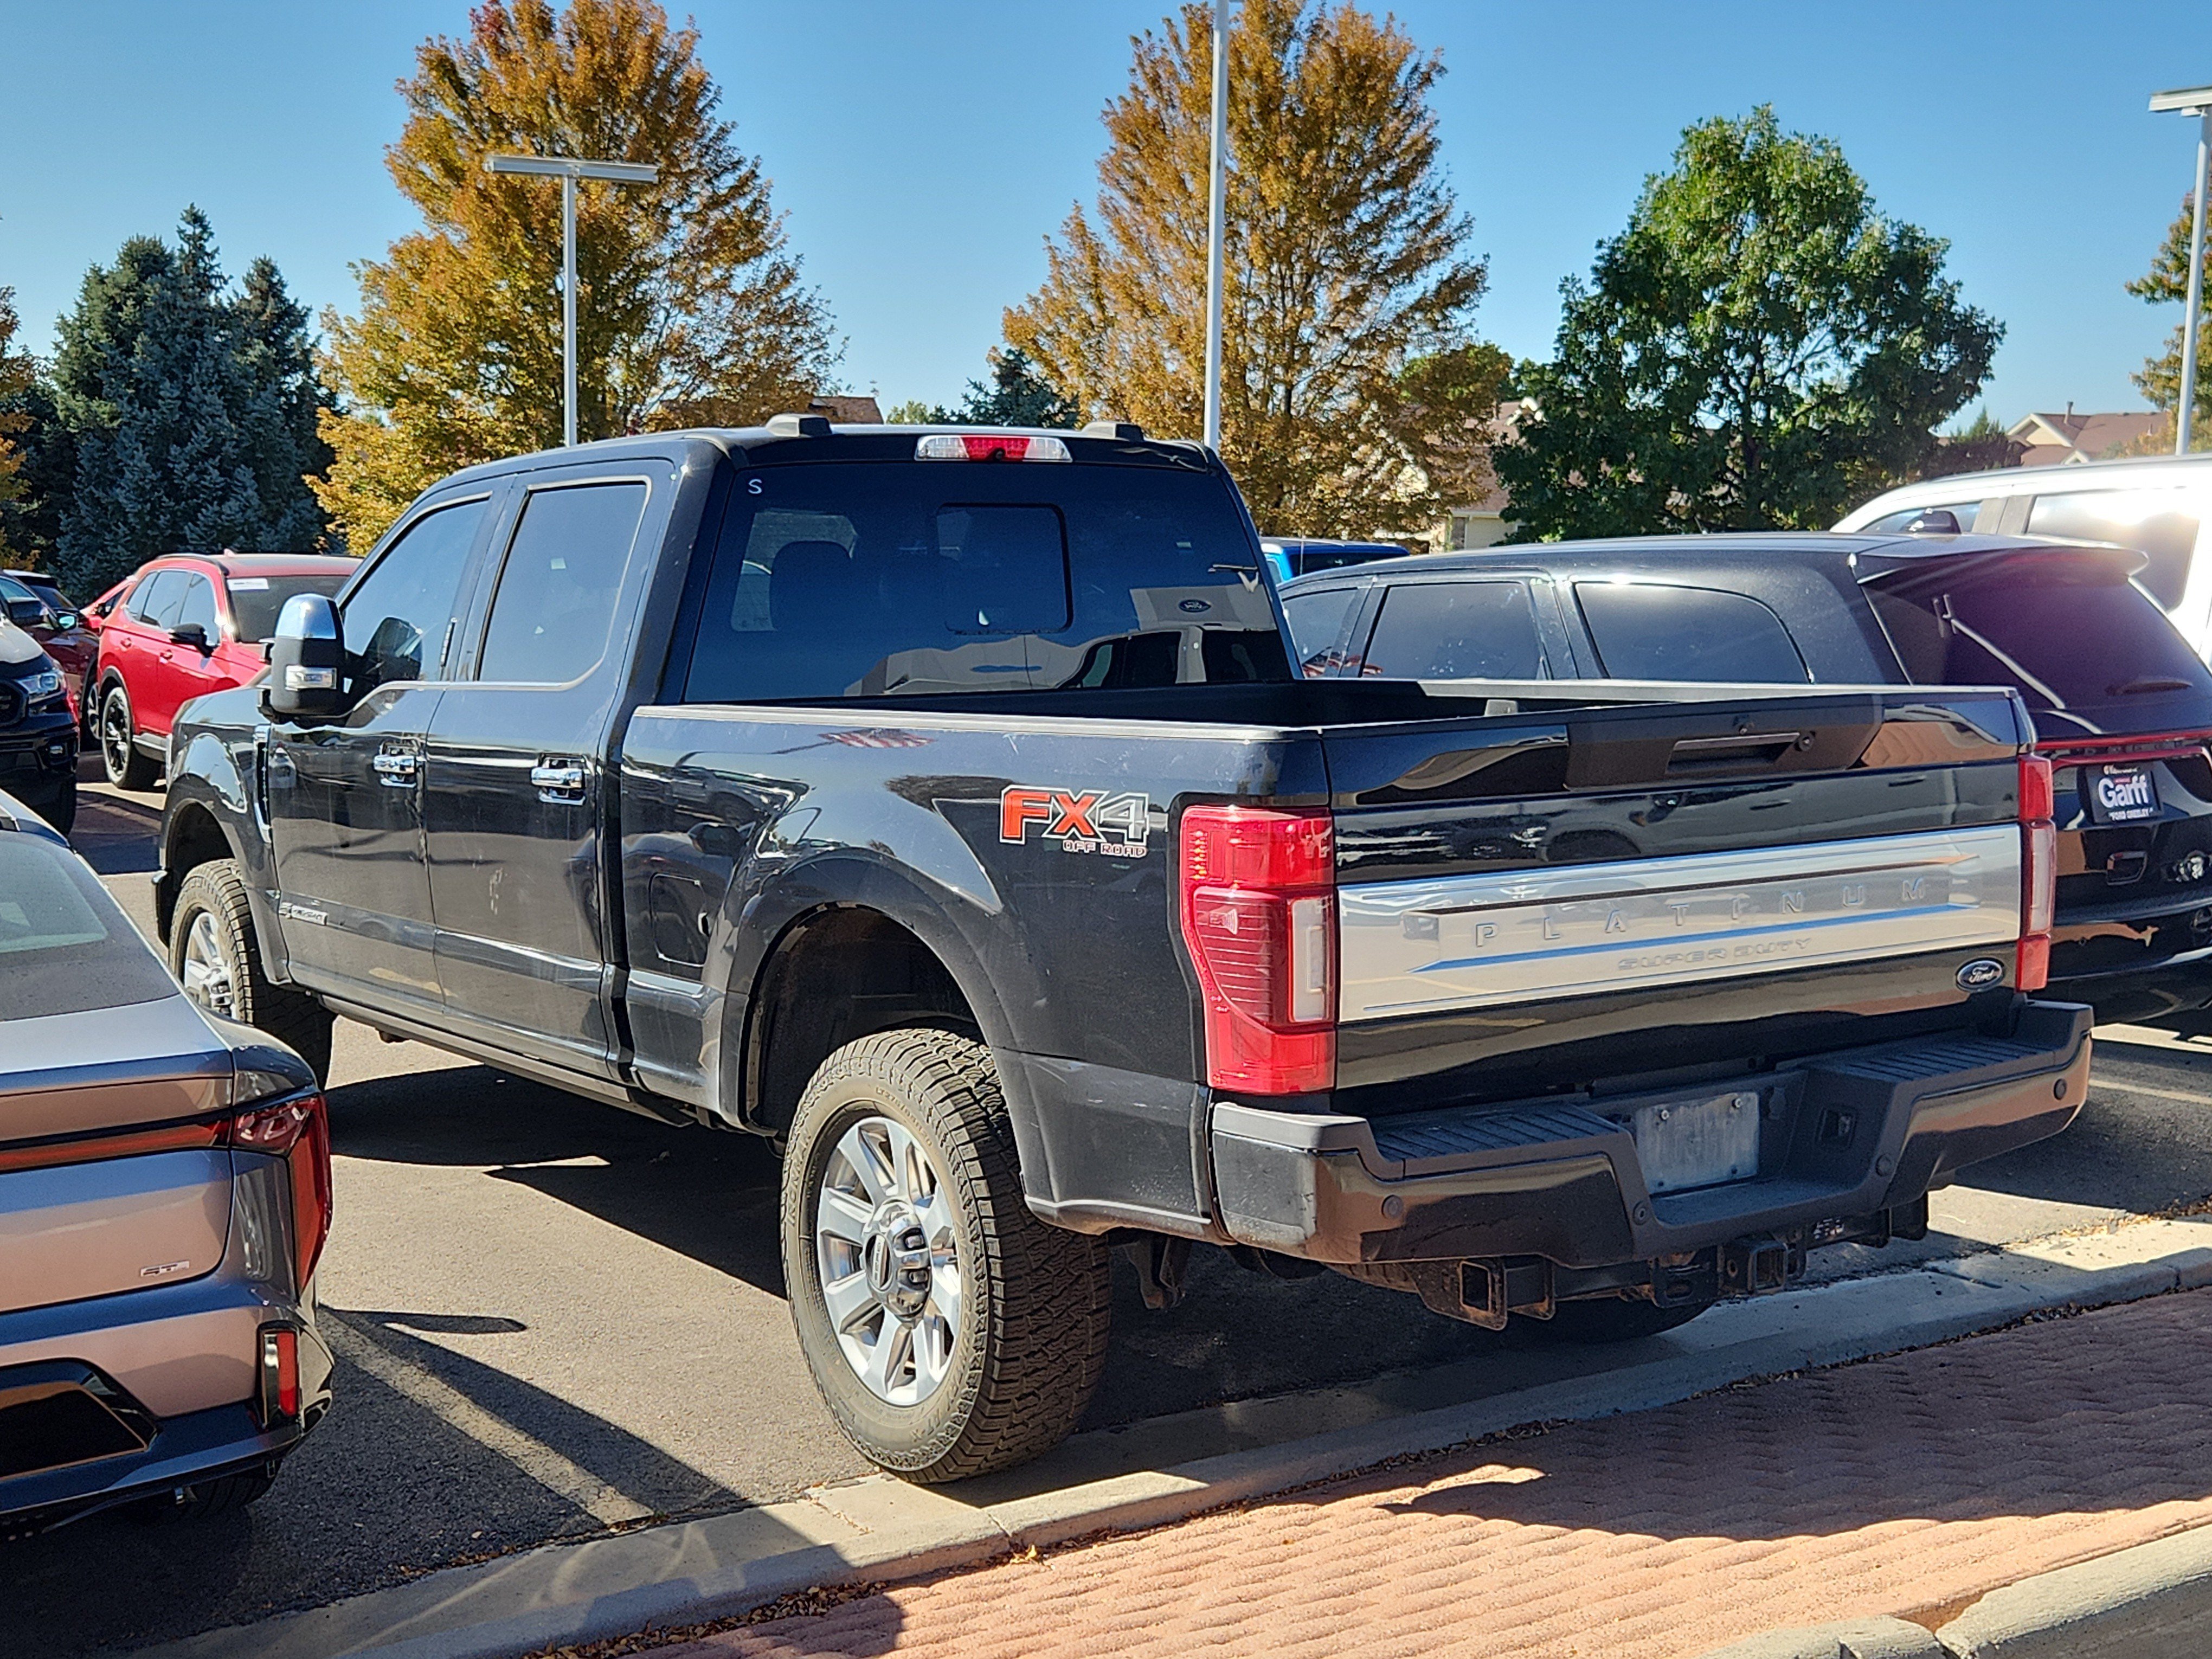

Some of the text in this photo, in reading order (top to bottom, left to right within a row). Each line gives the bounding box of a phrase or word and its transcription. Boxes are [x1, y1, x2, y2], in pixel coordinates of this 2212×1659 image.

[748, 479, 762, 494] S
[2098, 775, 2149, 808] Garff
[1000, 785, 1149, 845] FX4
[1063, 840, 1147, 858] OFF ROAD
[1476, 877, 1926, 947] PLATINUM
[1618, 937, 1811, 970] SUPER DUTY
[1969, 967, 1995, 983] Ford
[787, 1128, 811, 1226] IRONMAN
